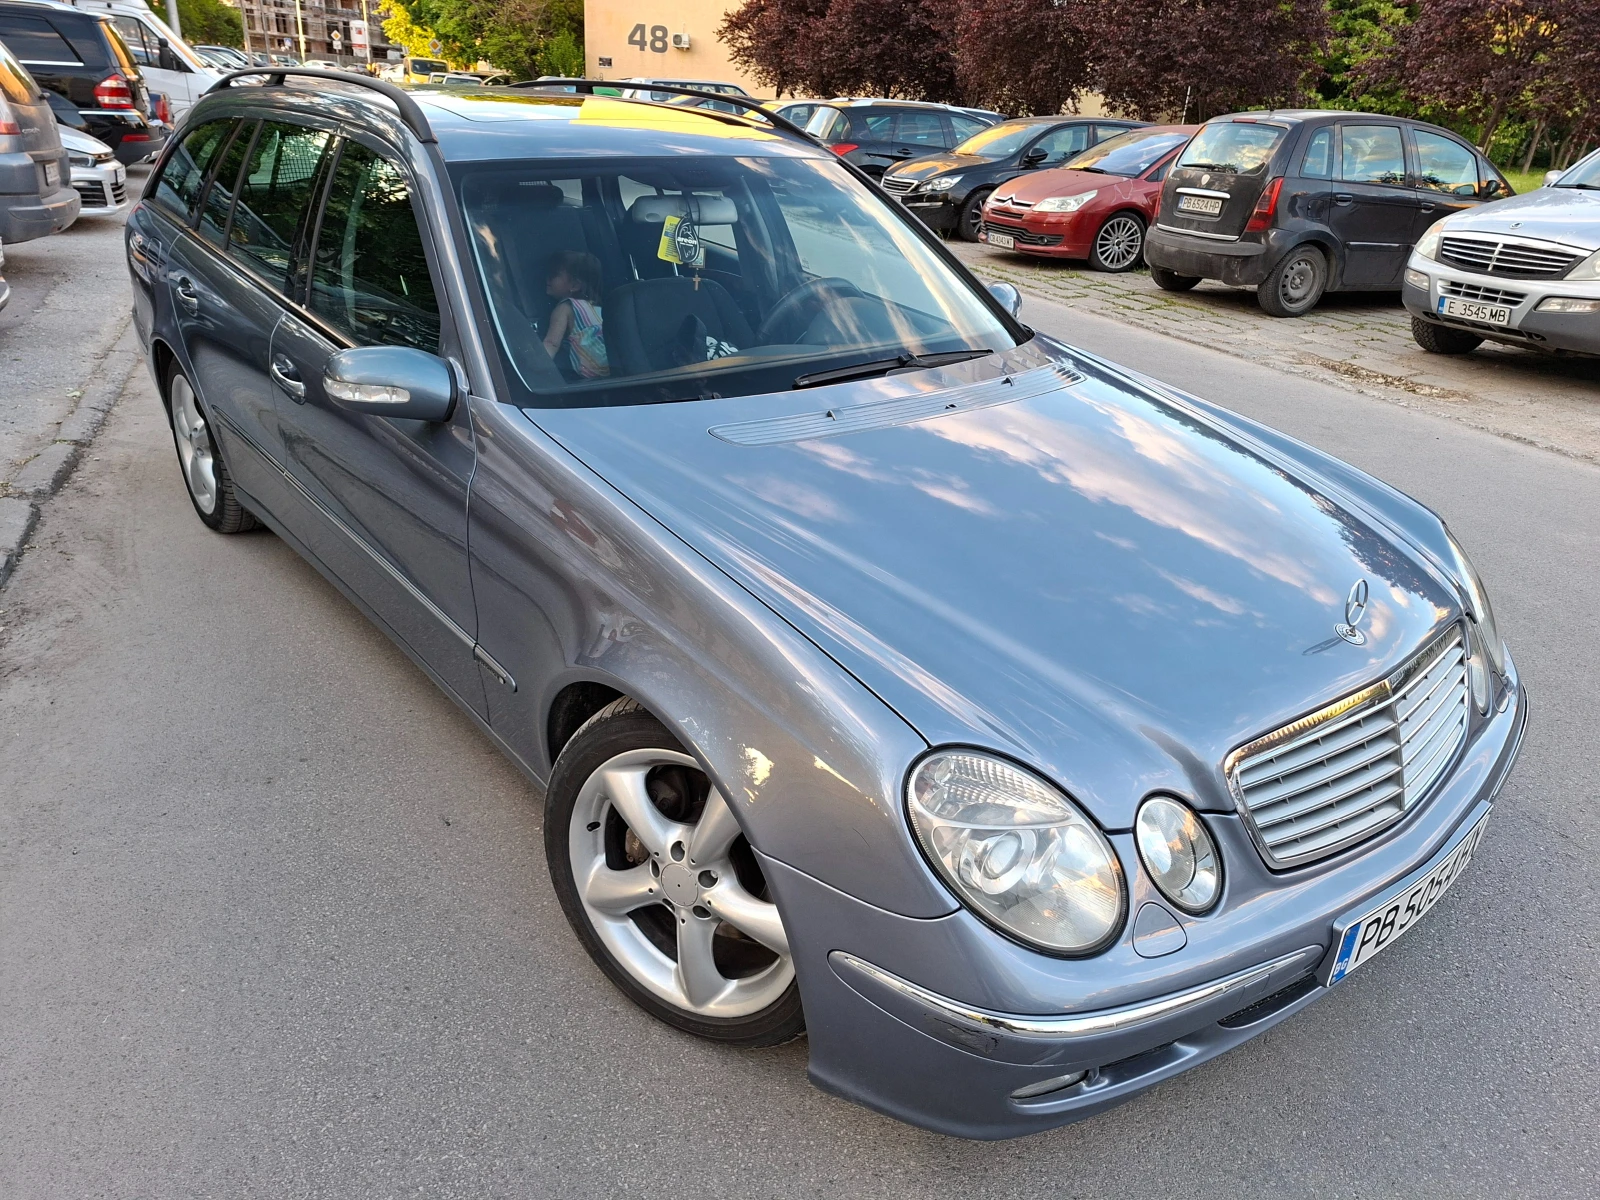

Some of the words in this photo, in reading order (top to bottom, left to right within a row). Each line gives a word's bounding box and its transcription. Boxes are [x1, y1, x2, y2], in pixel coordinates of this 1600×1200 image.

[628, 23, 668, 53] 48
[677, 236, 697, 245] areon
[1448, 301, 1455, 313] E
[1460, 304, 1487, 319] 3545
[1489, 308, 1506, 322] MB
[1354, 904, 1400, 963] PB
[1335, 957, 1348, 973] BG
